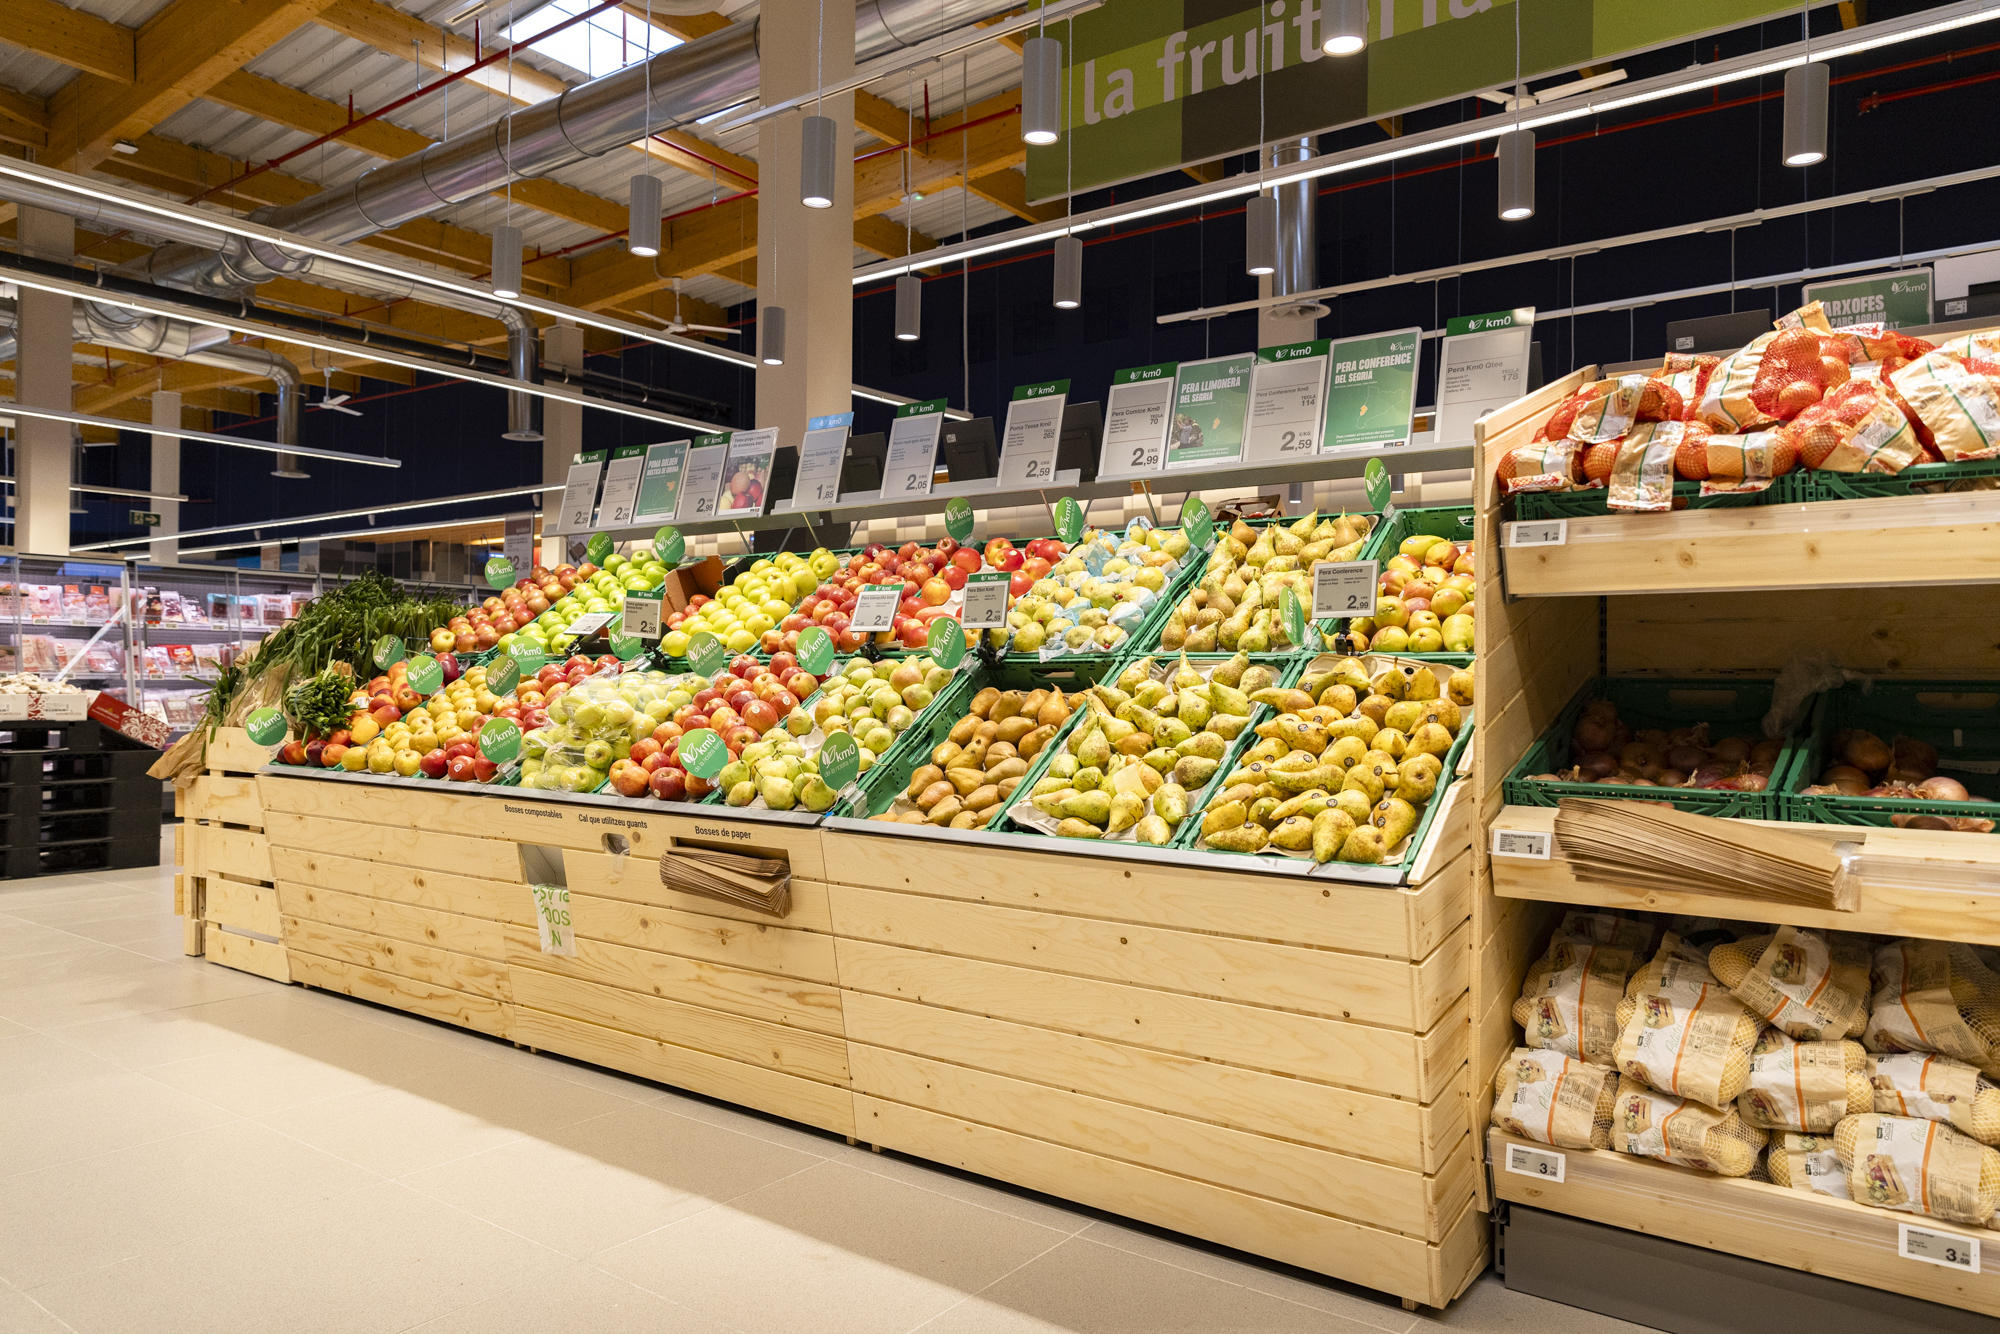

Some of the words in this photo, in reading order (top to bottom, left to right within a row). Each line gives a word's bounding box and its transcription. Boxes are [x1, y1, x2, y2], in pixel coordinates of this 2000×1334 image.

[1084, 59, 1135, 125] la
[1906, 283, 1927, 292] km0
[1824, 295, 1884, 317] ARXOFES
[1486, 316, 1511, 328] km0
[1856, 312, 1886, 324] AGRARI
[1290, 346, 1311, 357] km0
[1336, 361, 1356, 374] PERA
[1358, 352, 1411, 370] CONFERENCE
[1143, 368, 1161, 378] km0
[1334, 374, 1347, 384] DEL
[1348, 369, 1372, 382] SEGRIÀ
[1038, 386, 1055, 394] km0
[1181, 382, 1200, 394] PERA
[1201, 377, 1241, 392] LLIMONERA
[1268, 388, 1296, 396] Conference
[1180, 394, 1191, 404] DEL
[919, 404, 934, 412] km0
[829, 417, 842, 426] km0
[1280, 431, 1312, 452] 2,59
[648, 459, 661, 468] POMA
[661, 457, 678, 466] GOLDEN
[1131, 448, 1158, 466] 2,99
[1026, 460, 1050, 478] 2,59
[906, 474, 927, 490] 2,05
[1375, 466, 1386, 491] km0
[817, 484, 834, 500] 1,85
[696, 498, 713, 513] 2,99
[957, 506, 971, 520] km0
[1065, 500, 1073, 522] km0
[574, 511, 589, 525] 2,29
[614, 507, 629, 520] 2,09
[1194, 505, 1206, 524] km0
[666, 530, 679, 546] km0
[498, 565, 513, 574] km0
[1347, 595, 1368, 610] 2,99
[640, 621, 656, 633] 2,39
[941, 620, 955, 645] km0
[384, 636, 396, 654] km0
[701, 638, 717, 656] km0
[810, 632, 826, 652] km0
[524, 646, 542, 656] km0
[816, 648, 825, 659] nostra
[420, 660, 437, 676] km0
[499, 660, 514, 677] km0
[262, 713, 281, 728] km0
[496, 725, 516, 742] km0
[696, 733, 716, 755] km0
[704, 750, 715, 762] nostra
[836, 744, 856, 763] km0
[835, 761, 849, 771] nostra
[504, 805, 524, 814] Bosses
[525, 807, 562, 819] compostables
[578, 814, 588, 822] Cal
[589, 816, 600, 825] que
[601, 817, 625, 826] utilitzeu
[627, 819, 647, 828] guants
[695, 825, 719, 838] Bosses
[720, 828, 729, 838] de
[731, 830, 751, 841] paper
[1665, 1023, 1682, 1055] Patates
[1778, 1044, 1793, 1074] Patates
[1539, 1081, 1554, 1110] Patates
